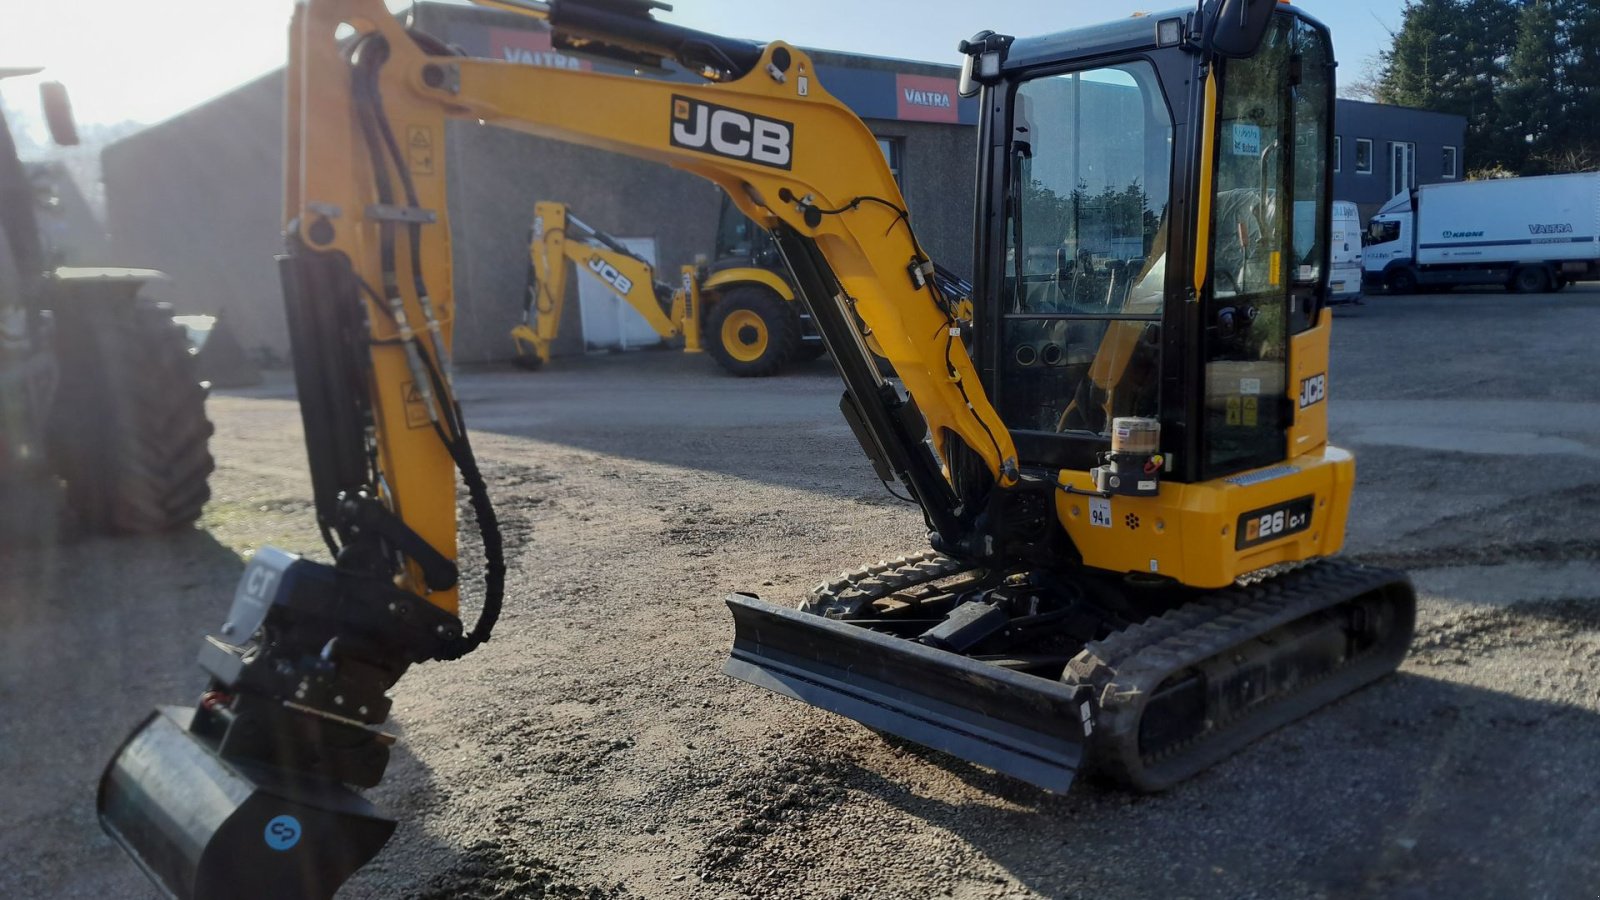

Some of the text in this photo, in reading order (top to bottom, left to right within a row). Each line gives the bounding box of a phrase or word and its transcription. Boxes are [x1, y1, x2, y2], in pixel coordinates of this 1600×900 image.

[904, 88, 950, 108] VALTRA
[673, 104, 790, 165] JCB
[1452, 231, 1484, 239] KRONE
[1528, 223, 1573, 235] VALTRA
[588, 259, 632, 295] JCB
[1300, 374, 1325, 407] JCB
[1092, 510, 1104, 524] 94
[1259, 510, 1284, 537] 26
[246, 565, 276, 598] CT
